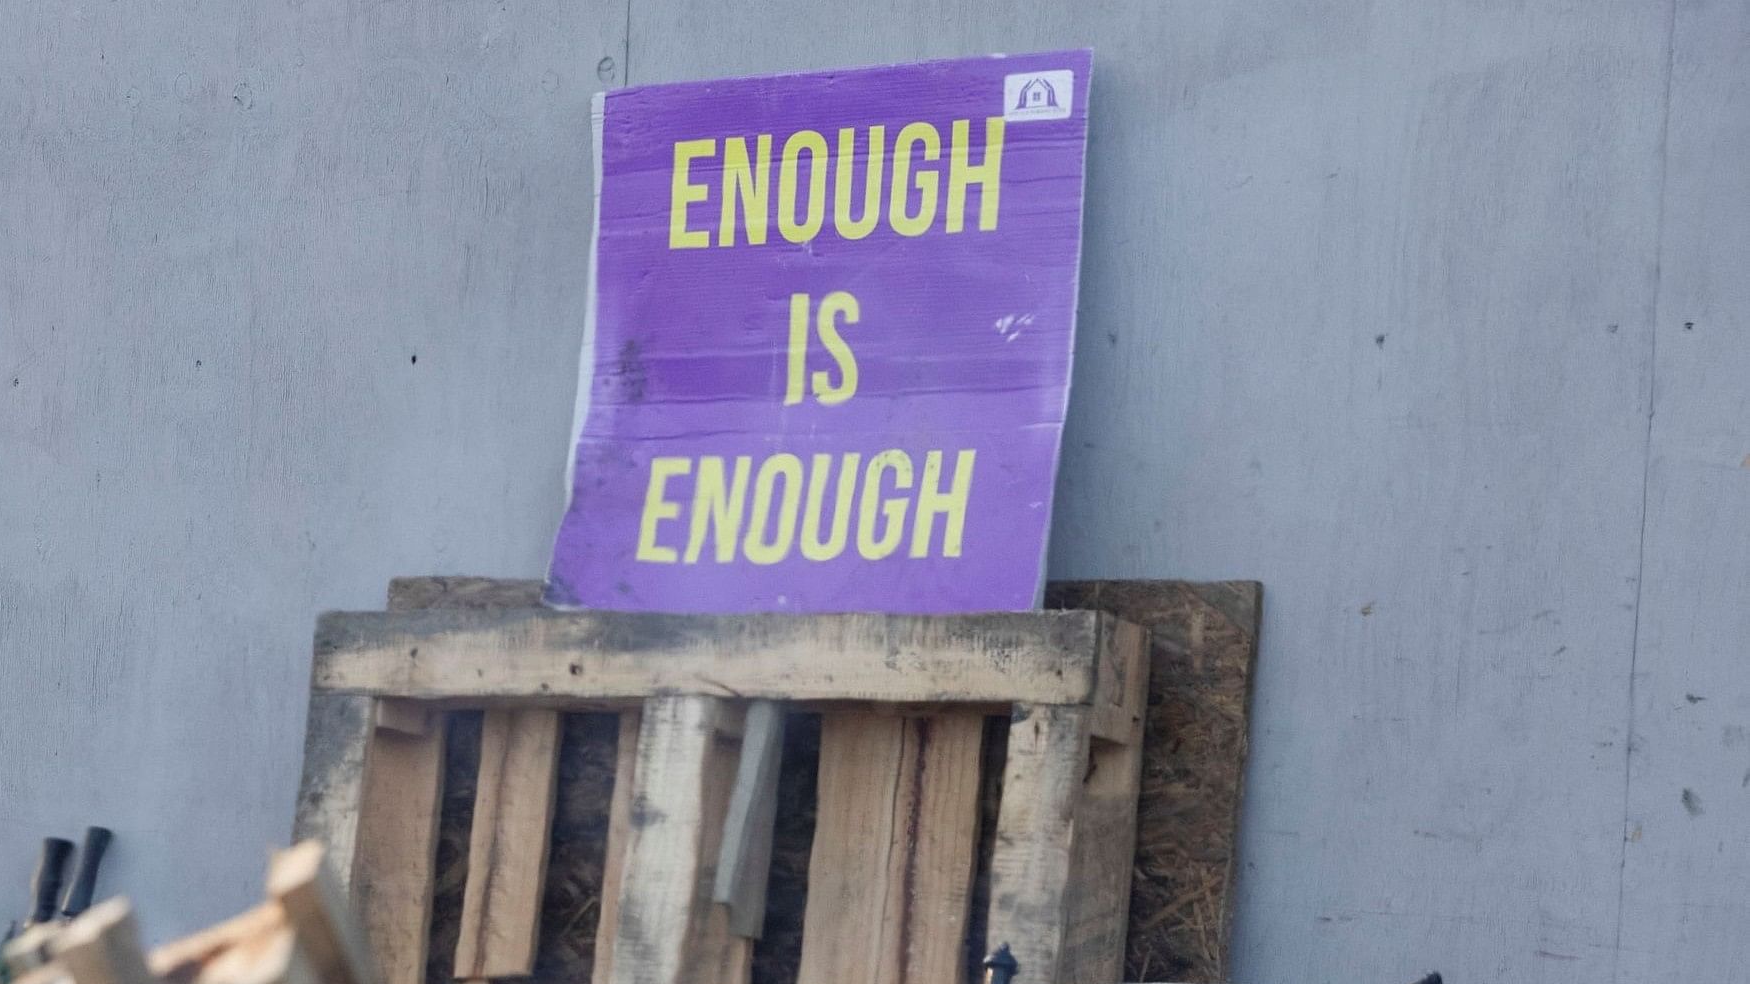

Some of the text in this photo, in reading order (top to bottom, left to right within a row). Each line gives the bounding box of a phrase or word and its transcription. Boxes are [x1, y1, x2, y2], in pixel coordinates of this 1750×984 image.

[669, 116, 1006, 249] ENOUGH
[784, 290, 861, 406] IS
[635, 448, 976, 564] ENOUGH
